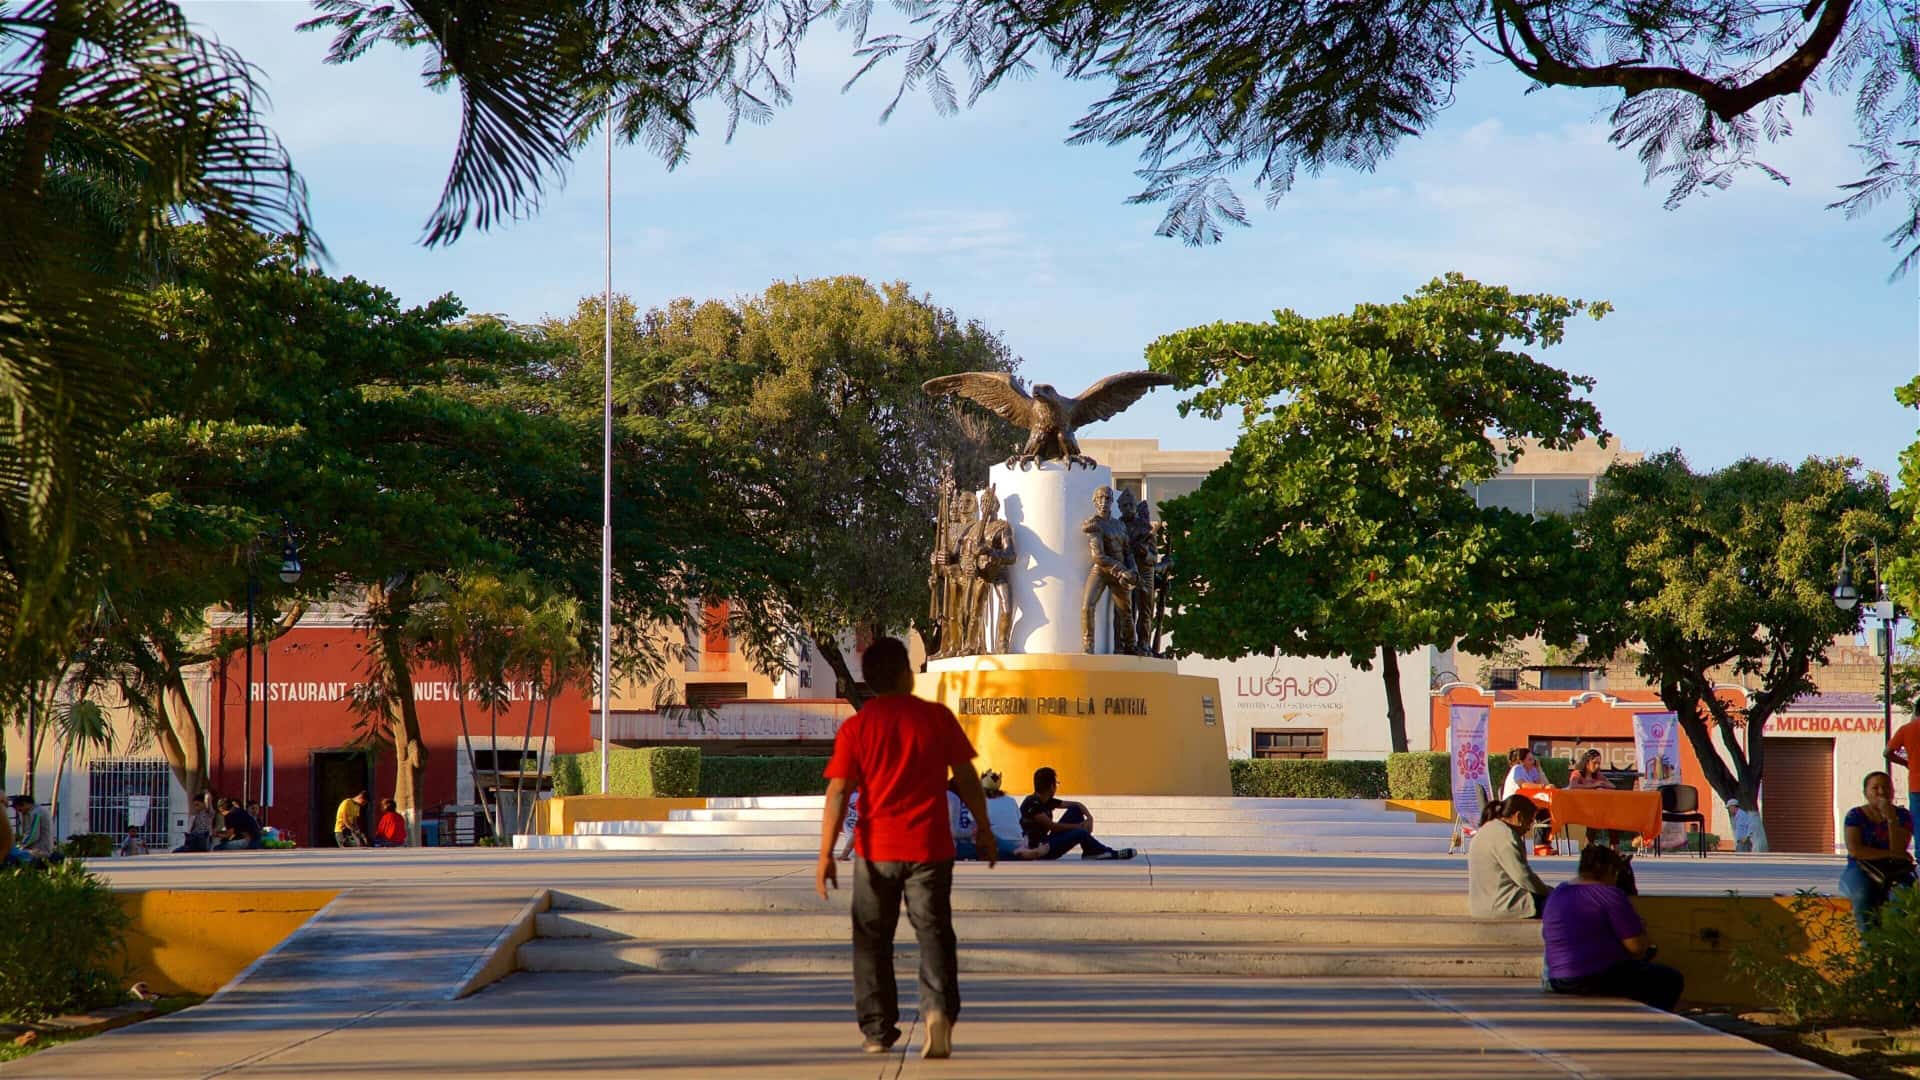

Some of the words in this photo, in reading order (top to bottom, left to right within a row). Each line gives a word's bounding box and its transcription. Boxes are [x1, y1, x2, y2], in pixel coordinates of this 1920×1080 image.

[250, 682, 347, 701] RESTAURANT
[414, 682, 461, 701] NUEVO
[1237, 676, 1337, 701] LUGAJO
[1037, 697, 1068, 715] POR
[1077, 697, 1096, 715] LA
[1104, 697, 1148, 715] PATRIA
[1776, 717, 1886, 732] MICHOACANA
